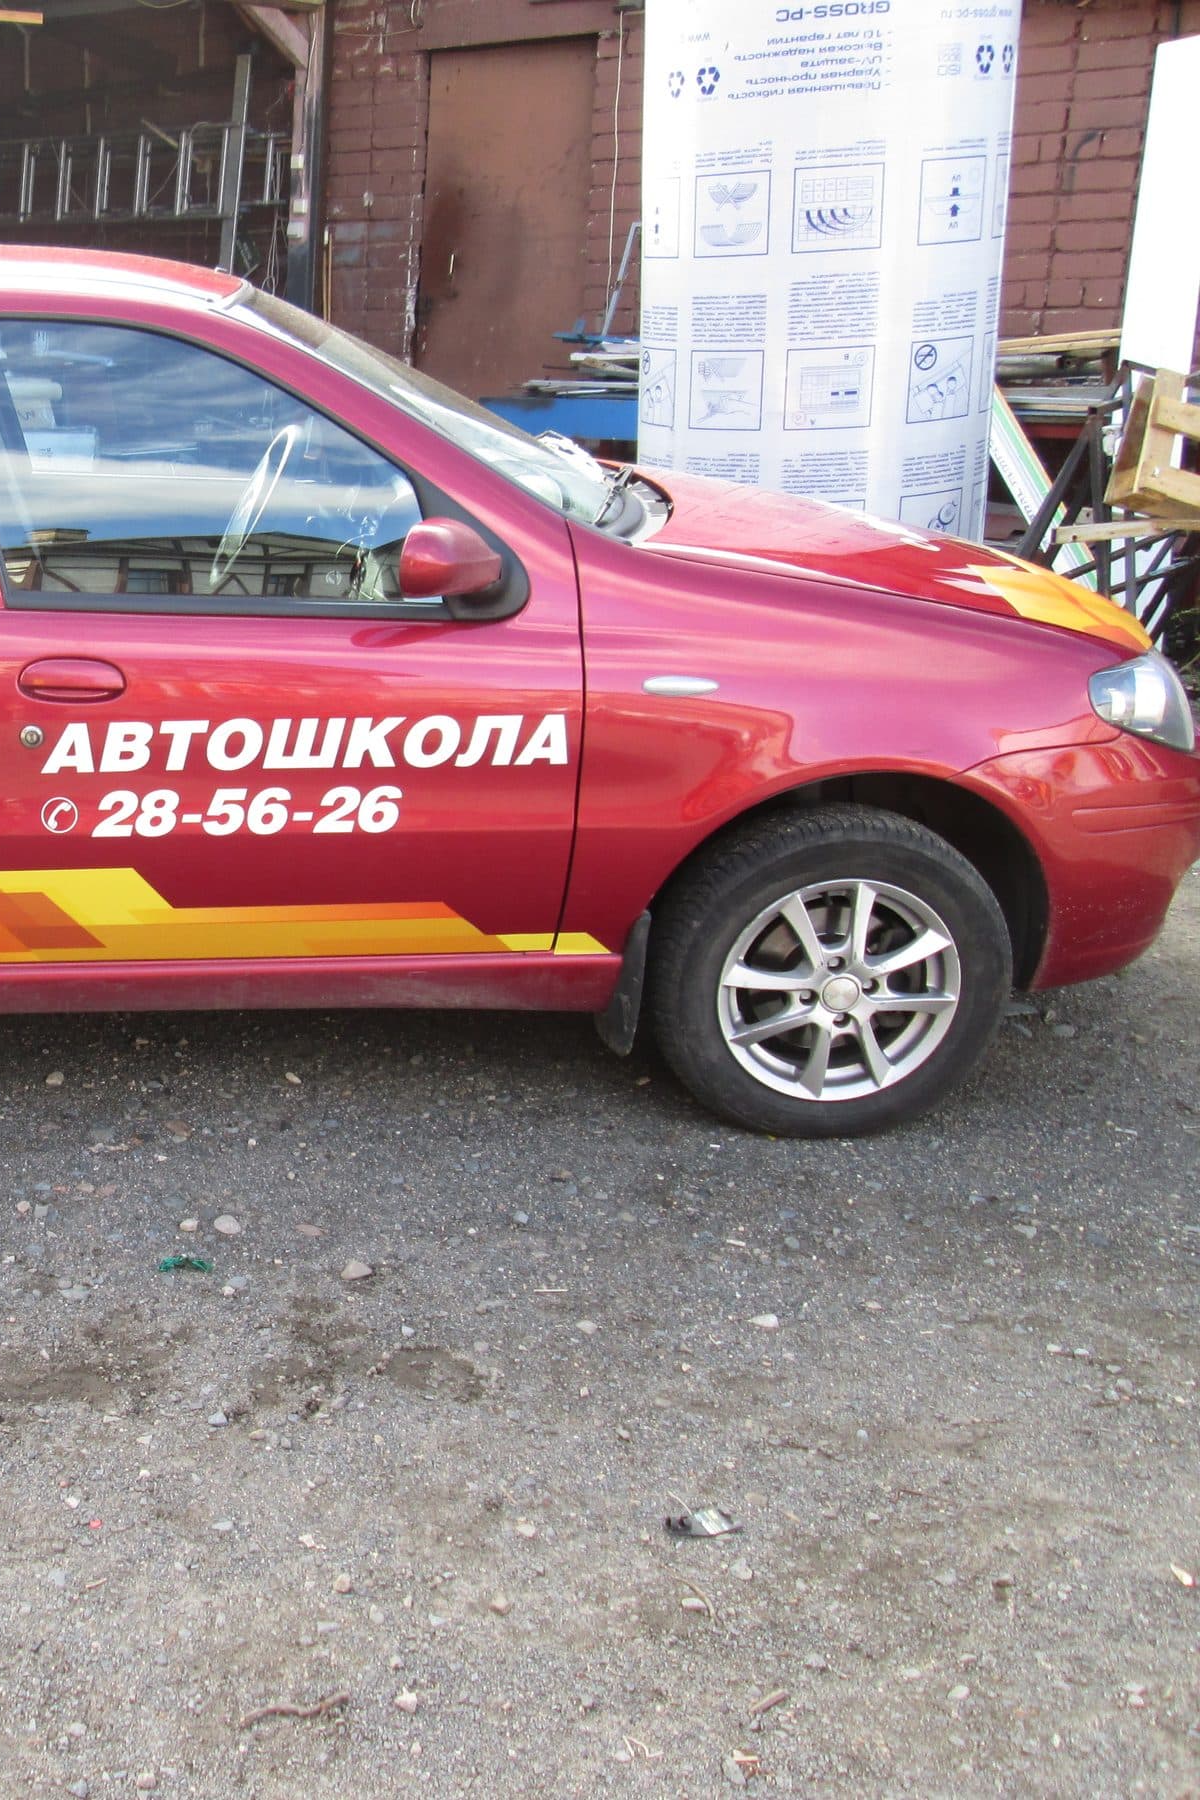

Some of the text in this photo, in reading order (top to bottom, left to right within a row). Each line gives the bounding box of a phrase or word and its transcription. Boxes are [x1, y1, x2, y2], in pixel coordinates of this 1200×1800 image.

[775, 1, 891, 23] GROSS-PC
[766, 32, 832, 46] гарантии
[744, 71, 817, 86] прочность
[727, 87, 785, 101] гибкость
[41, 713, 569, 774] АВТОШКОЛА
[91, 785, 404, 838] 28-56-26
